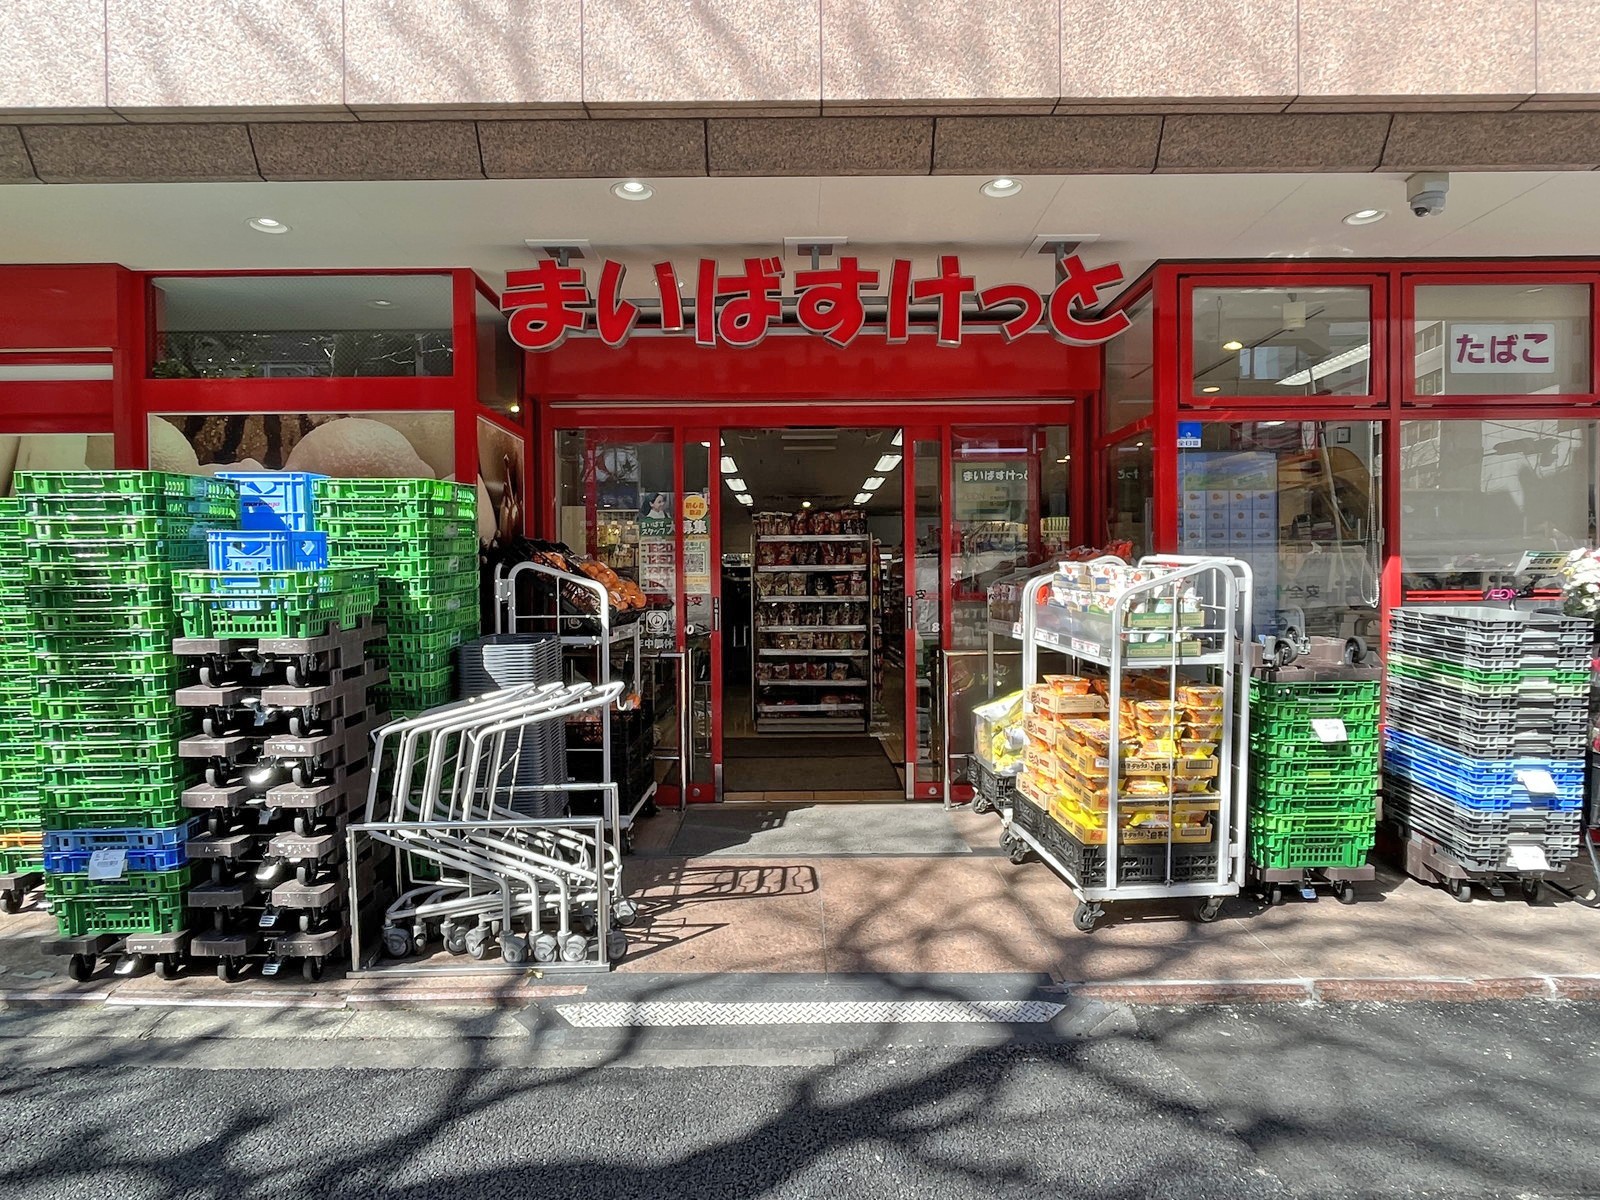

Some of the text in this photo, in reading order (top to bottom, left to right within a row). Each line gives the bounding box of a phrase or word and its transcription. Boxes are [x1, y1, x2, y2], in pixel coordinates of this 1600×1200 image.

[502, 254, 1133, 350] まいばすけっと
[1456, 333, 1550, 364] たばこ
